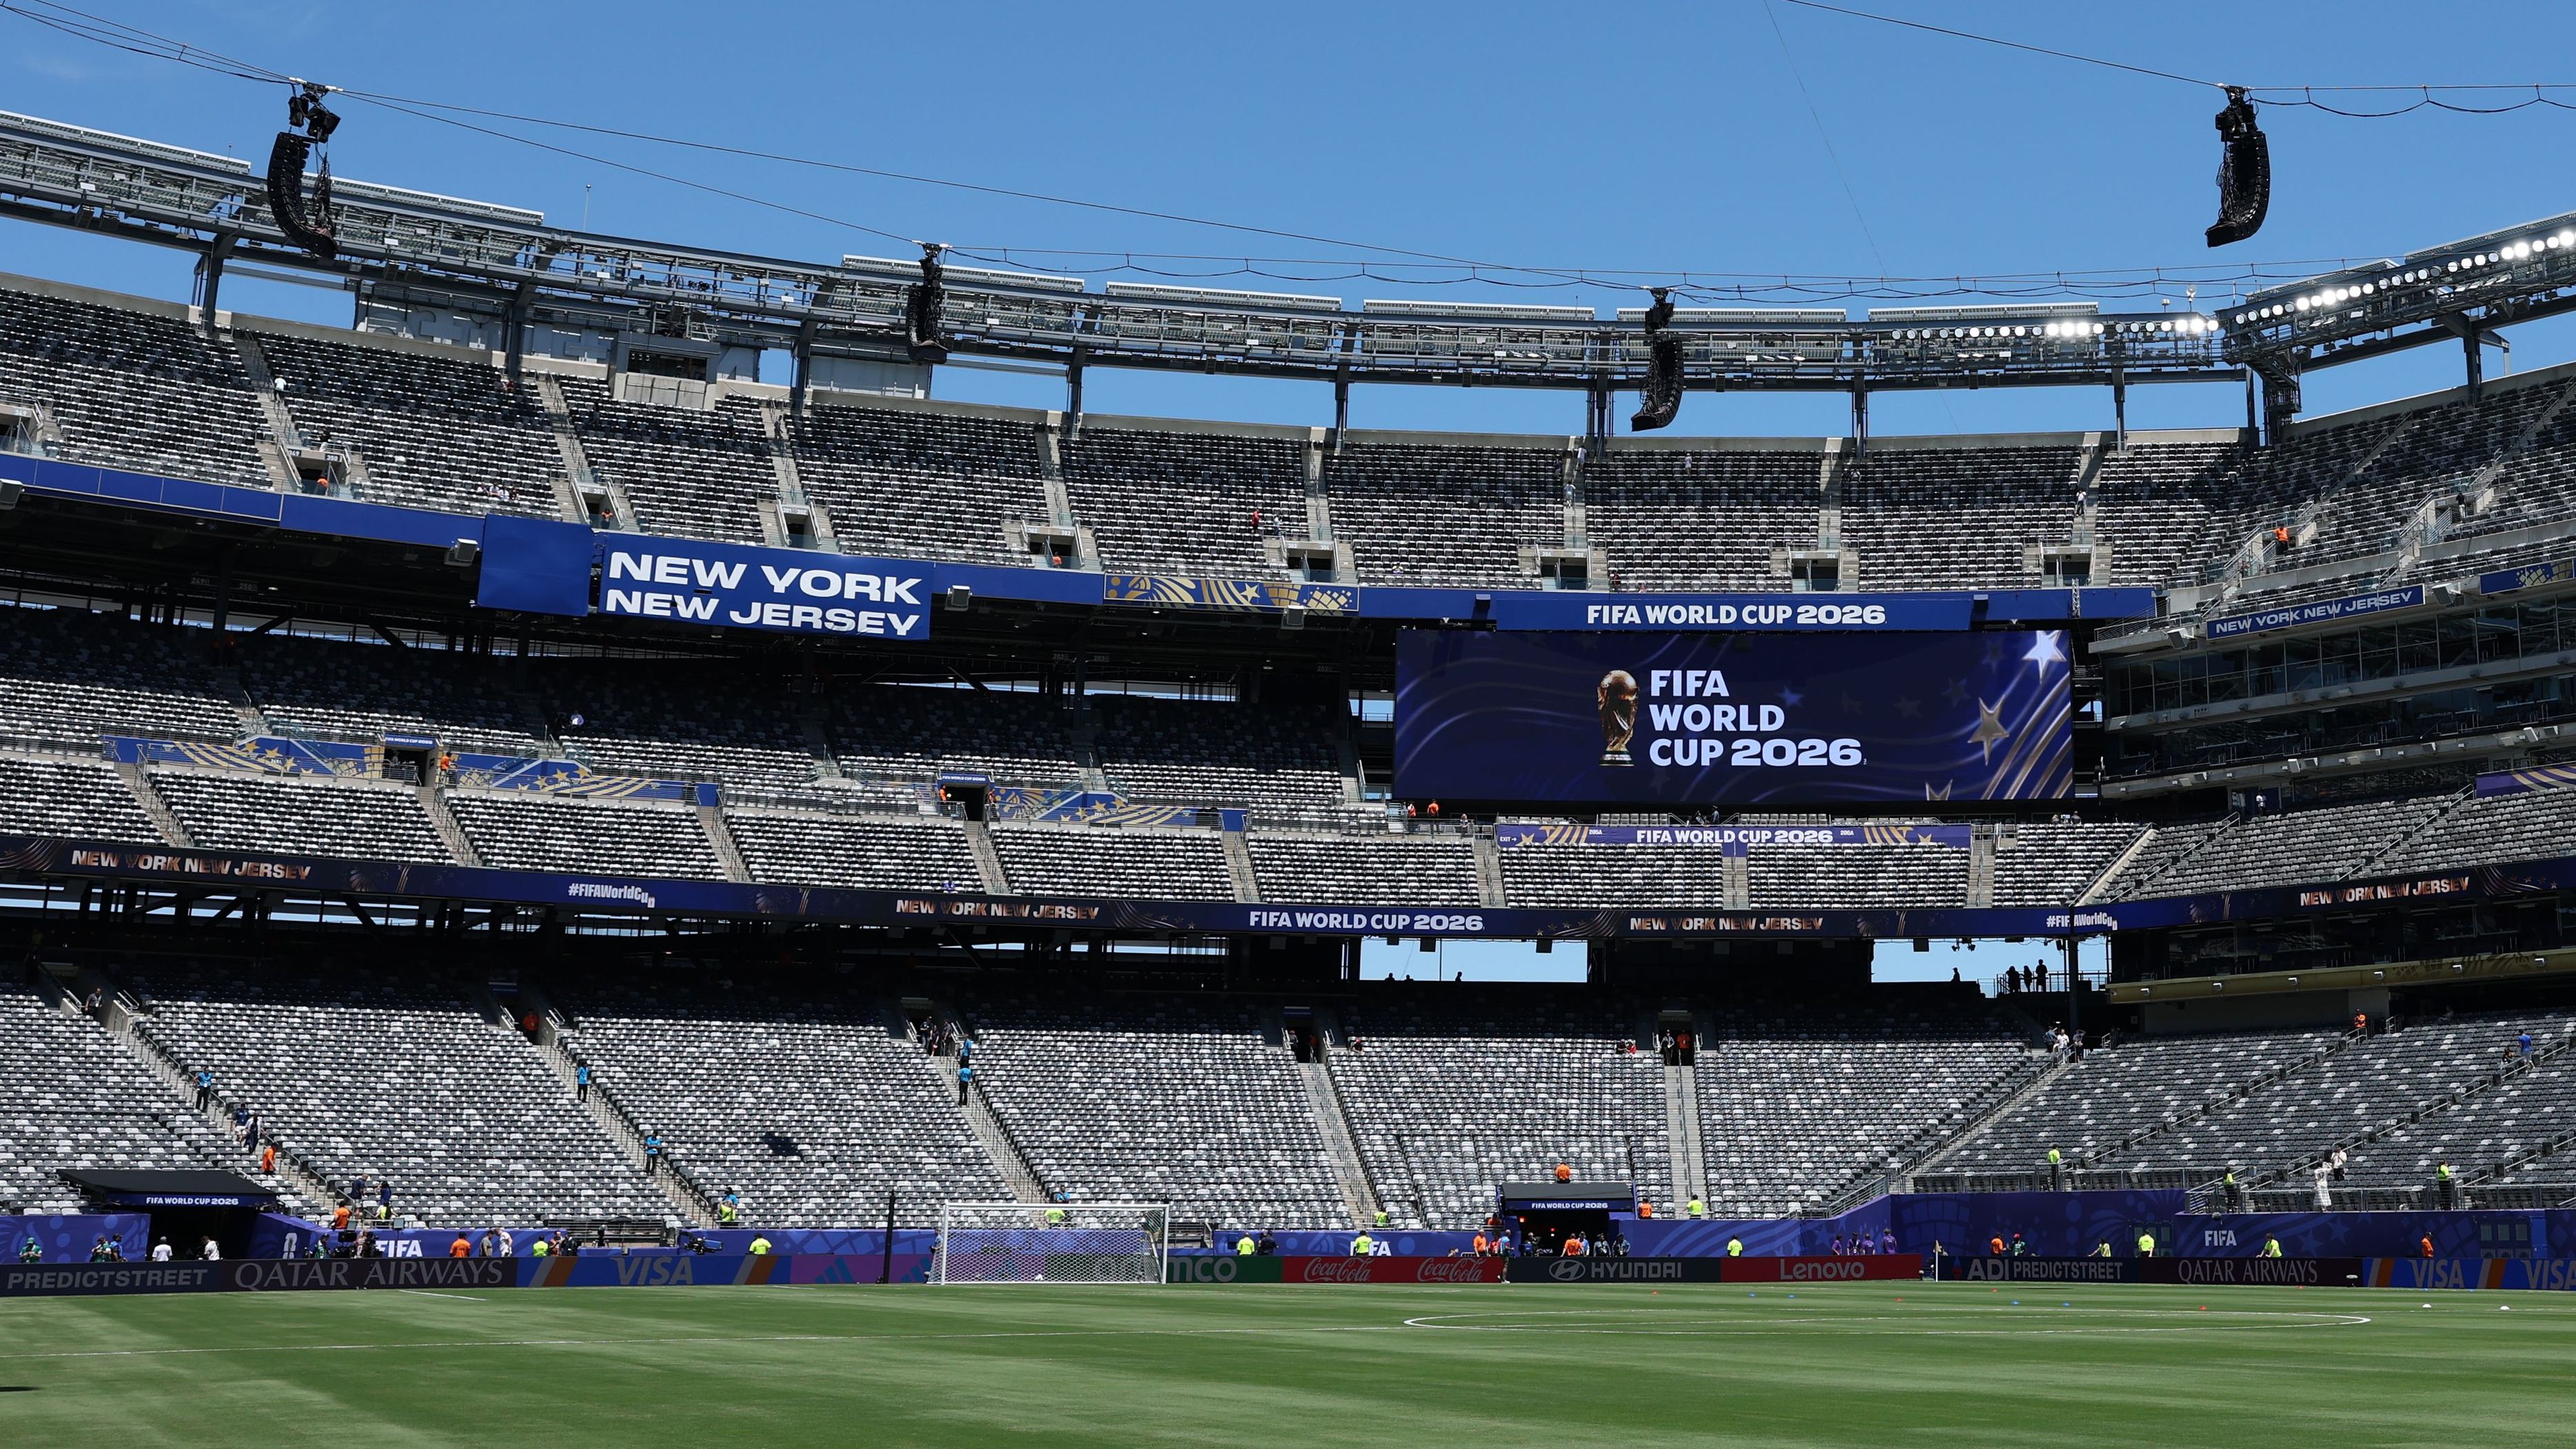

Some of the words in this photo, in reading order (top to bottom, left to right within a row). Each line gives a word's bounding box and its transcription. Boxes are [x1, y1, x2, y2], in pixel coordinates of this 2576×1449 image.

[609, 552, 748, 589] NEW
[760, 564, 922, 605] YORK
[605, 589, 720, 620] NEW
[730, 602, 921, 636] JERSEY
[1587, 605, 1642, 624] FIFA
[1645, 605, 1738, 625] WORLD
[1741, 605, 1792, 625] CUP
[1797, 605, 1886, 625] 2026
[2216, 619, 2252, 634] NEW
[2255, 611, 2301, 627] YORK
[2304, 604, 2342, 620] NEW
[2345, 591, 2414, 612] JERSEY
[1650, 670, 1730, 697] FIFA
[1649, 704, 1786, 732] WORLD
[1649, 738, 1724, 767] CUP
[1730, 738, 1863, 767] 2026
[1637, 830, 1674, 843] FIFA
[1674, 830, 1736, 843] WORLD
[1738, 830, 1772, 843] CUP
[1774, 830, 1834, 843] 2026
[72, 850, 122, 867] NEW
[125, 854, 182, 871] YORK
[184, 858, 231, 875] NEW
[234, 861, 312, 880] JERSEY
[2300, 890, 2336, 907] NEW
[2337, 886, 2375, 903] YORK
[2376, 882, 2411, 900] NEW
[2412, 876, 2470, 897] JERSEY
[896, 899, 938, 914] NEW
[940, 901, 988, 916] YORK
[990, 903, 1032, 918] NEW
[1032, 905, 1100, 920] JERSEY
[1249, 911, 1292, 927] FIFA
[1295, 912, 1367, 929] WORLD
[1370, 913, 1410, 930] CUP
[1413, 915, 1484, 931] 2026
[1630, 918, 1668, 930] NEW
[1671, 918, 1716, 930] YORK
[1718, 918, 1756, 930] NEW
[1759, 918, 1824, 930] JERSEY
[375, 1240, 424, 1258] FIFA
[2204, 1230, 2237, 1247] FIFA
[8, 1269, 209, 1289] PREDICTSTREET
[235, 1261, 349, 1291] QATAR
[363, 1260, 504, 1286] AIRWAYS
[609, 1256, 694, 1285] VISA
[1304, 1257, 1374, 1282] Coca-Cola
[1417, 1257, 1488, 1282] Coca-Cola
[1591, 1262, 1682, 1278] HYUNDAI
[1780, 1258, 1865, 1280] Lenovo
[1967, 1259, 2009, 1280] ADI
[2013, 1260, 2123, 1280] PREDICTSTREET
[2178, 1260, 2236, 1285] QATAR
[2243, 1260, 2318, 1283] AIRWAYS
[2407, 1259, 2465, 1289] VISA
